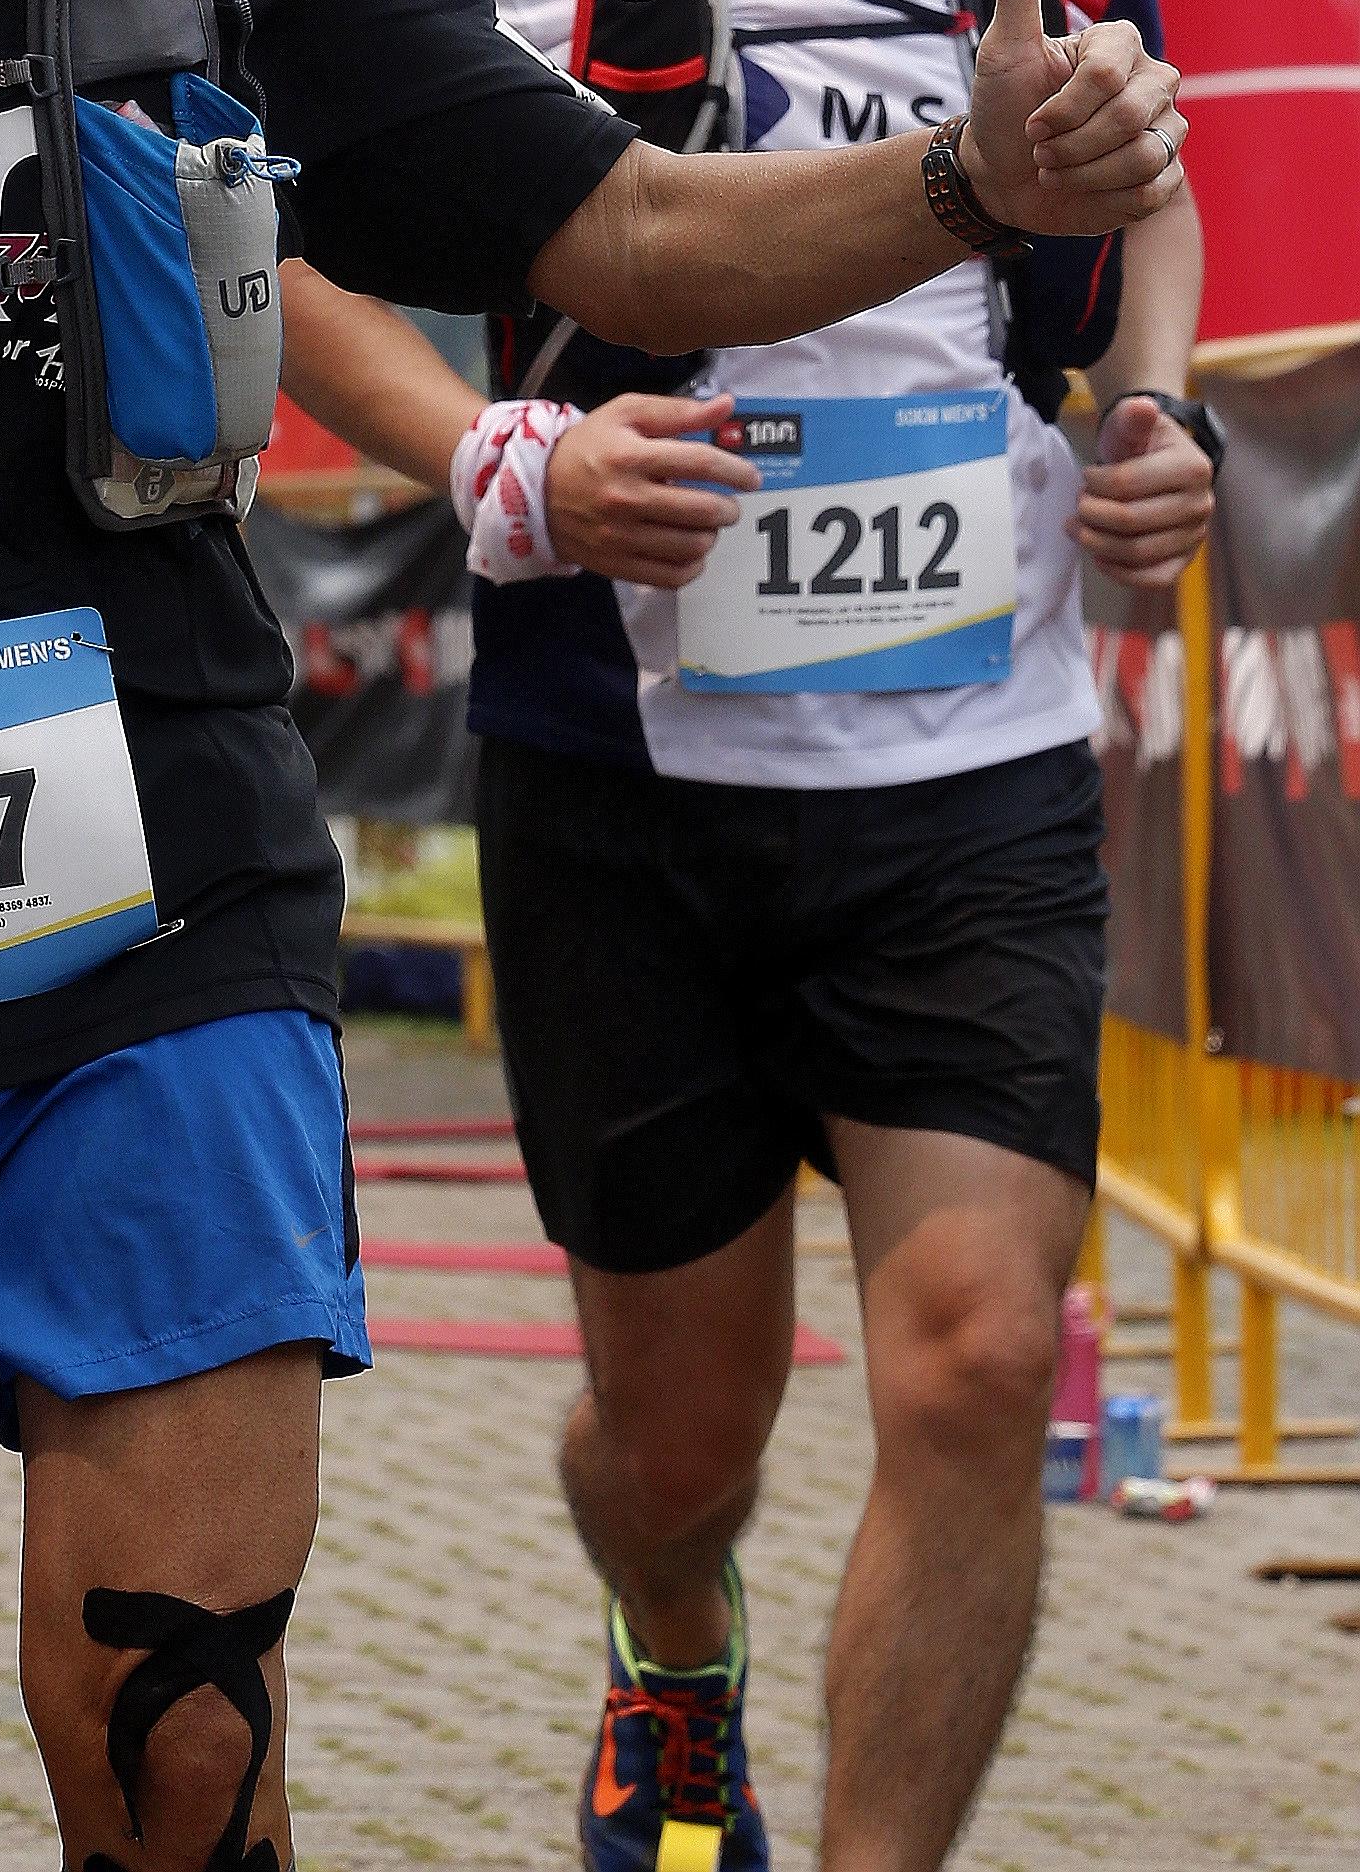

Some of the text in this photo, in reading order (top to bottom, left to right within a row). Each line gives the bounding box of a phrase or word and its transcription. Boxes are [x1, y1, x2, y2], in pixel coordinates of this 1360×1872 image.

[757, 501, 960, 596] 1212
[0, 901, 23, 912] 8369
[25, 895, 52, 908] 4837.
